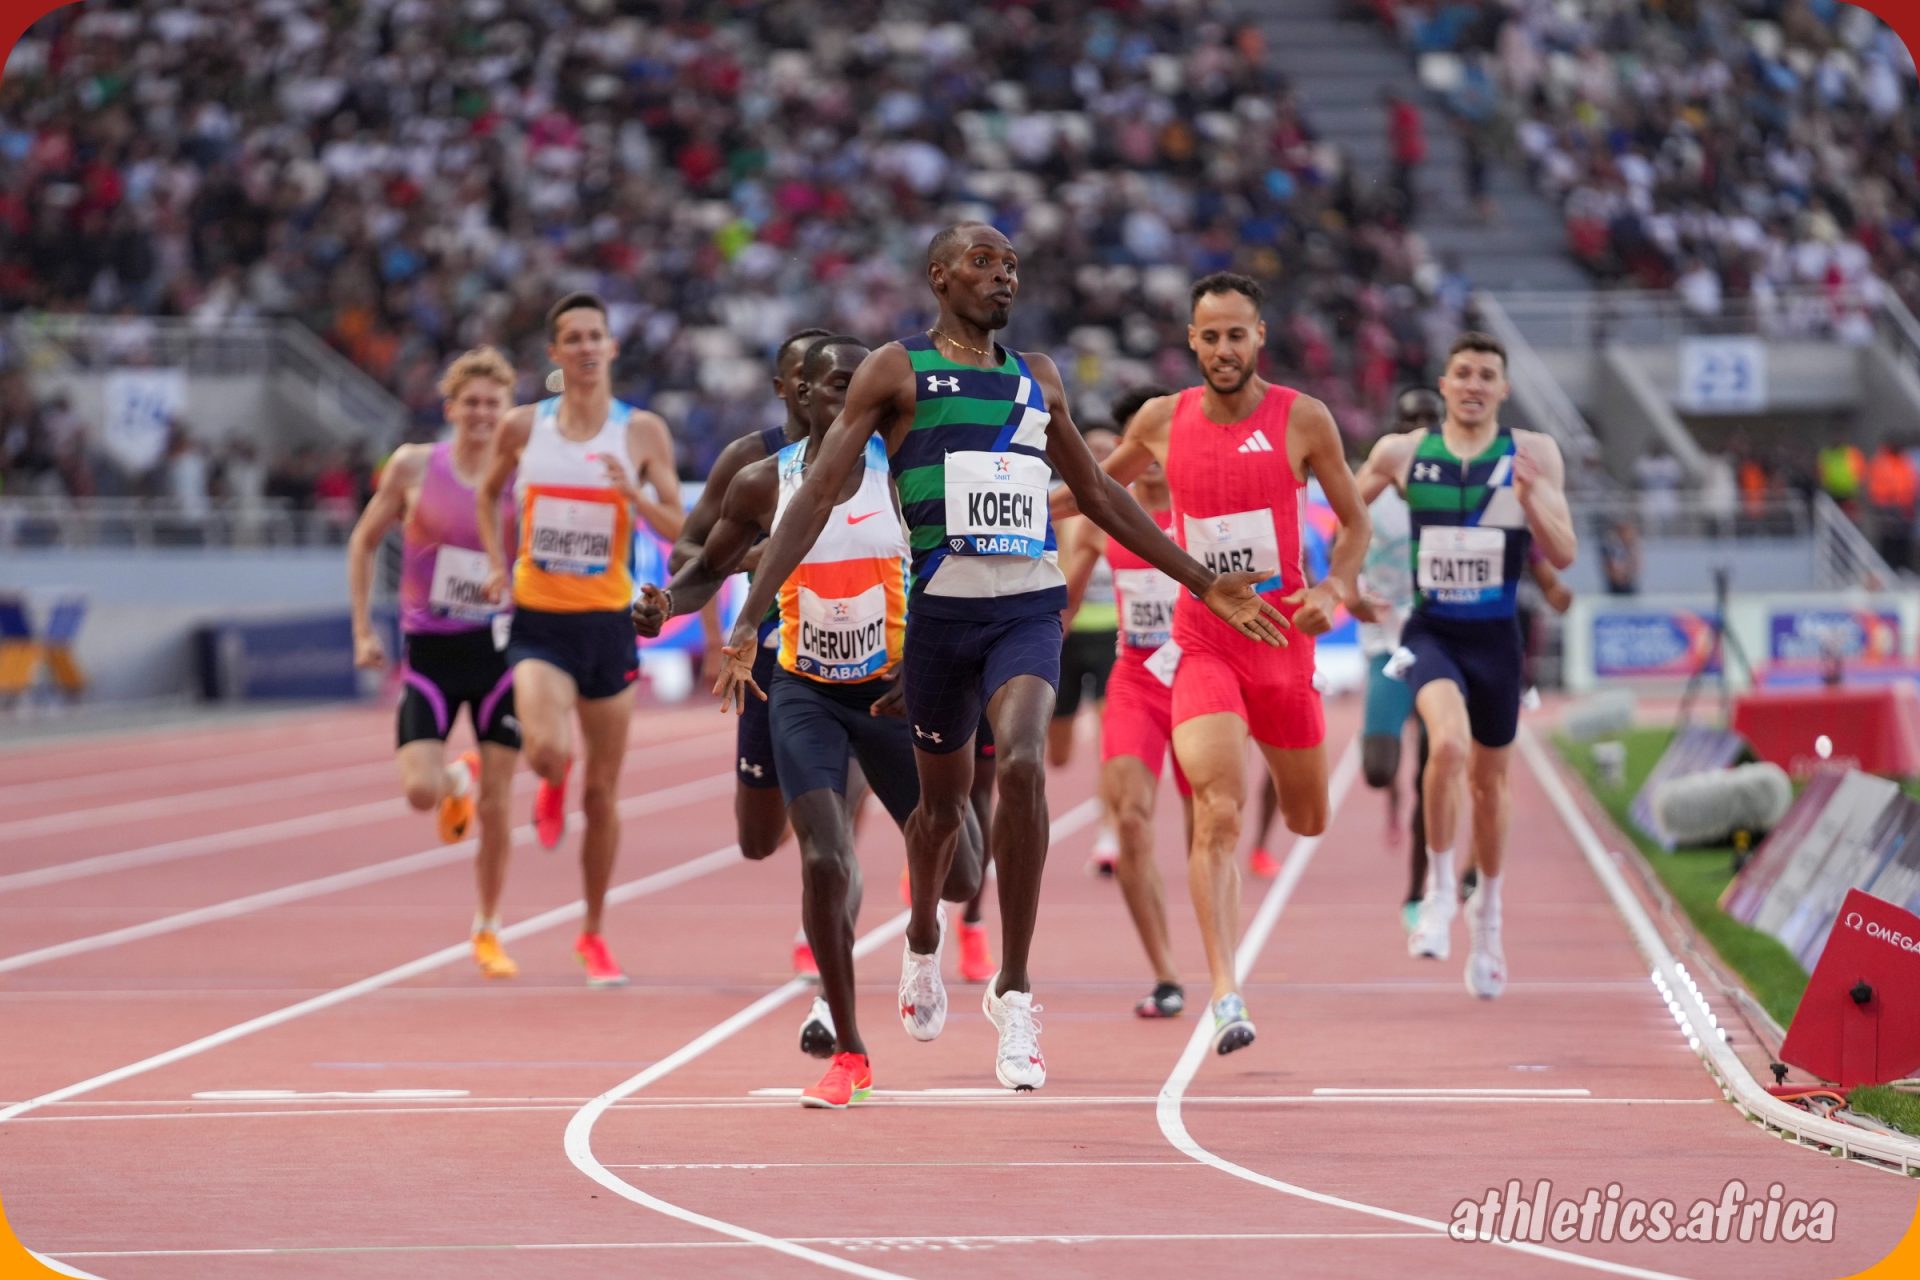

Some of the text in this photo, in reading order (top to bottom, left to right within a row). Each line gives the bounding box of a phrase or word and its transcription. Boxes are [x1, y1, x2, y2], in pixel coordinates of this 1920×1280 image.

[968, 491, 1033, 530] KOECH
[976, 537, 1029, 554] RABAT
[802, 616, 884, 660] CHERUIYOT
[819, 662, 869, 680] RABAT
[1865, 921, 1920, 955] OMEGA
